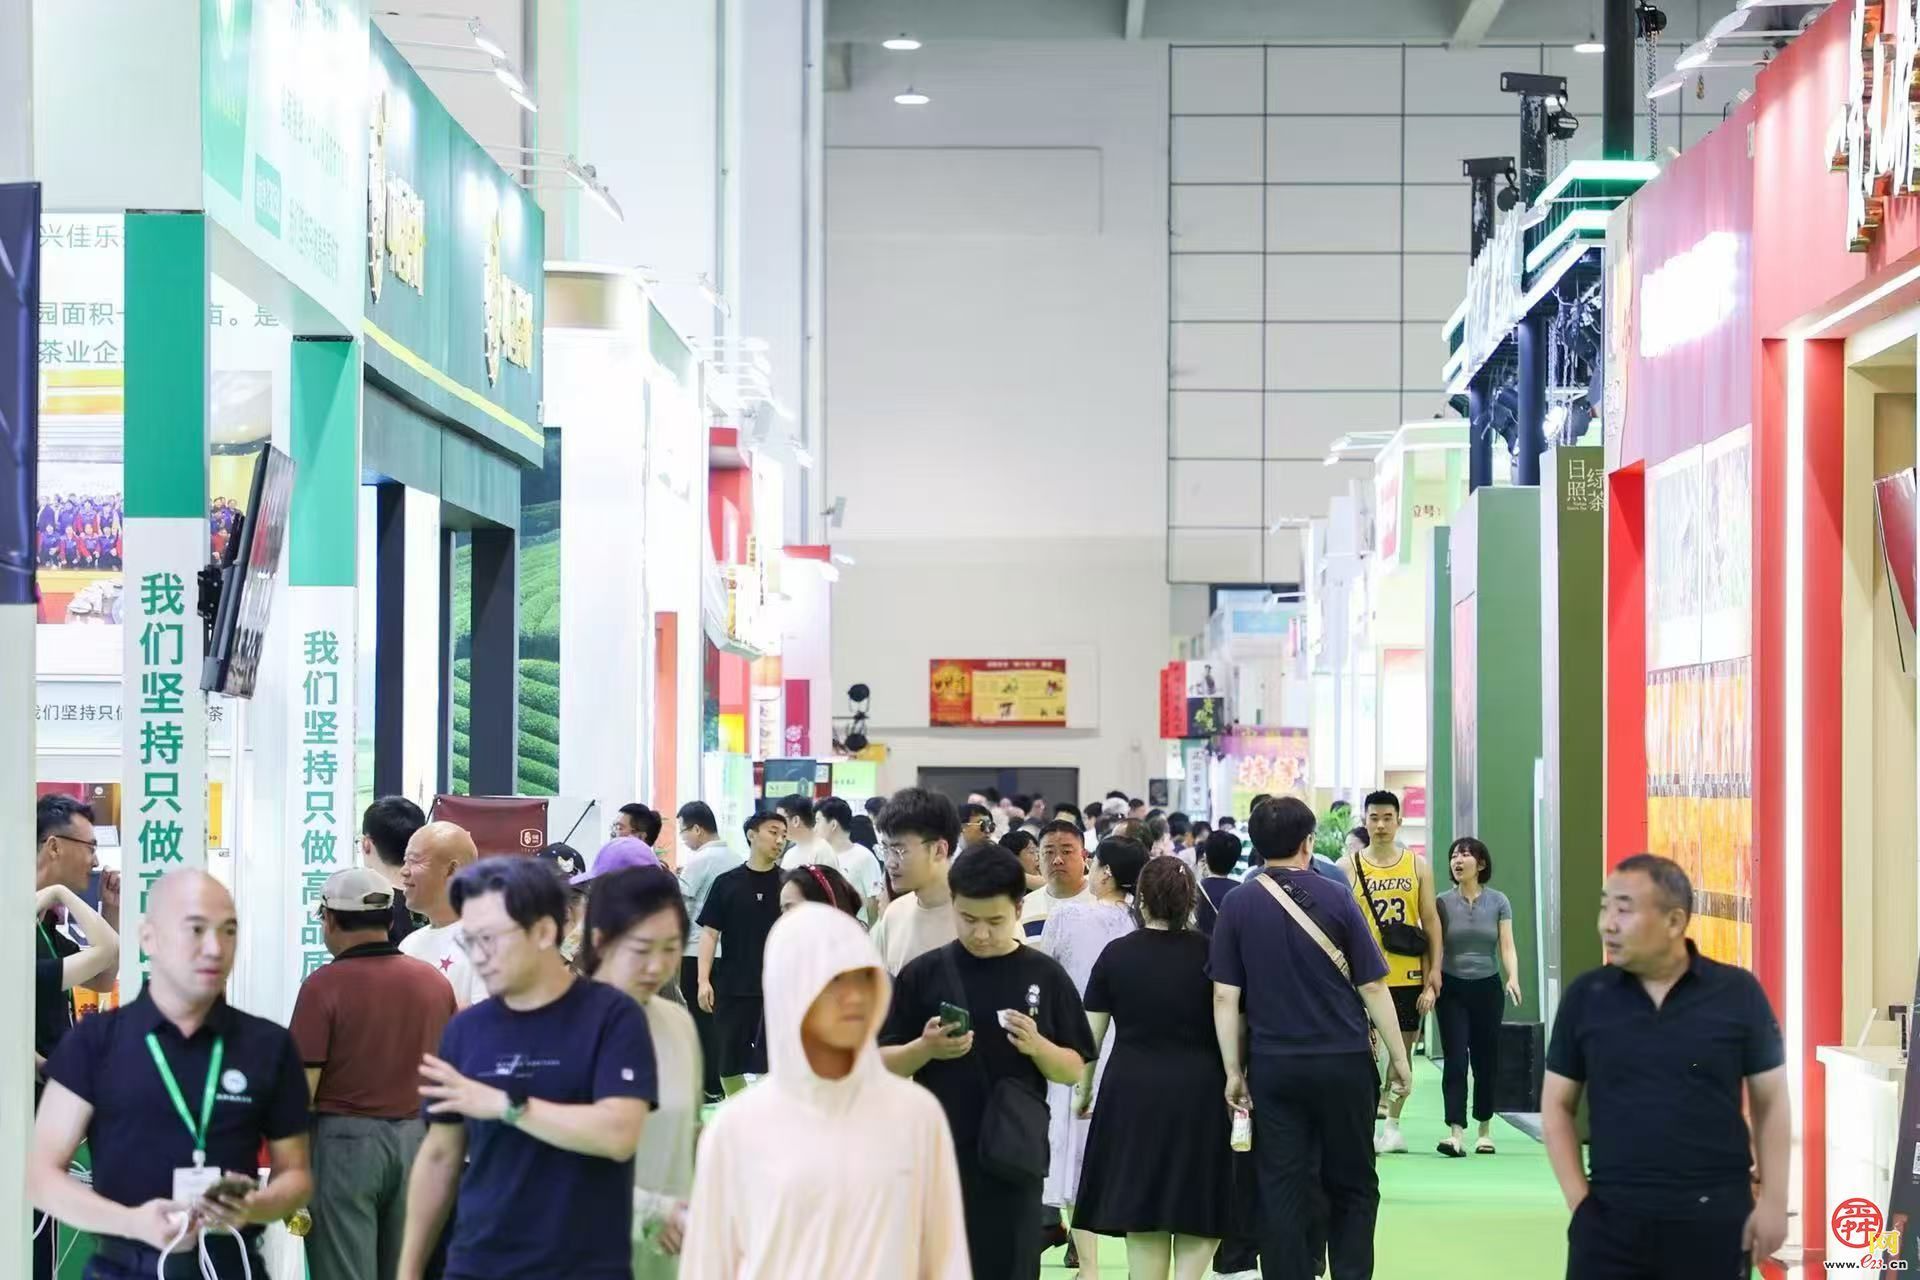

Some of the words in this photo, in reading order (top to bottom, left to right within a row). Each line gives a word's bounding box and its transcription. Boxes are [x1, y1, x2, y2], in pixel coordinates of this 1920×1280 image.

[39, 223, 125, 249] 兴佳乐
[39, 340, 125, 364] 茶业企
[1567, 459, 1587, 501] 日照
[1373, 897, 1406, 926] 23
